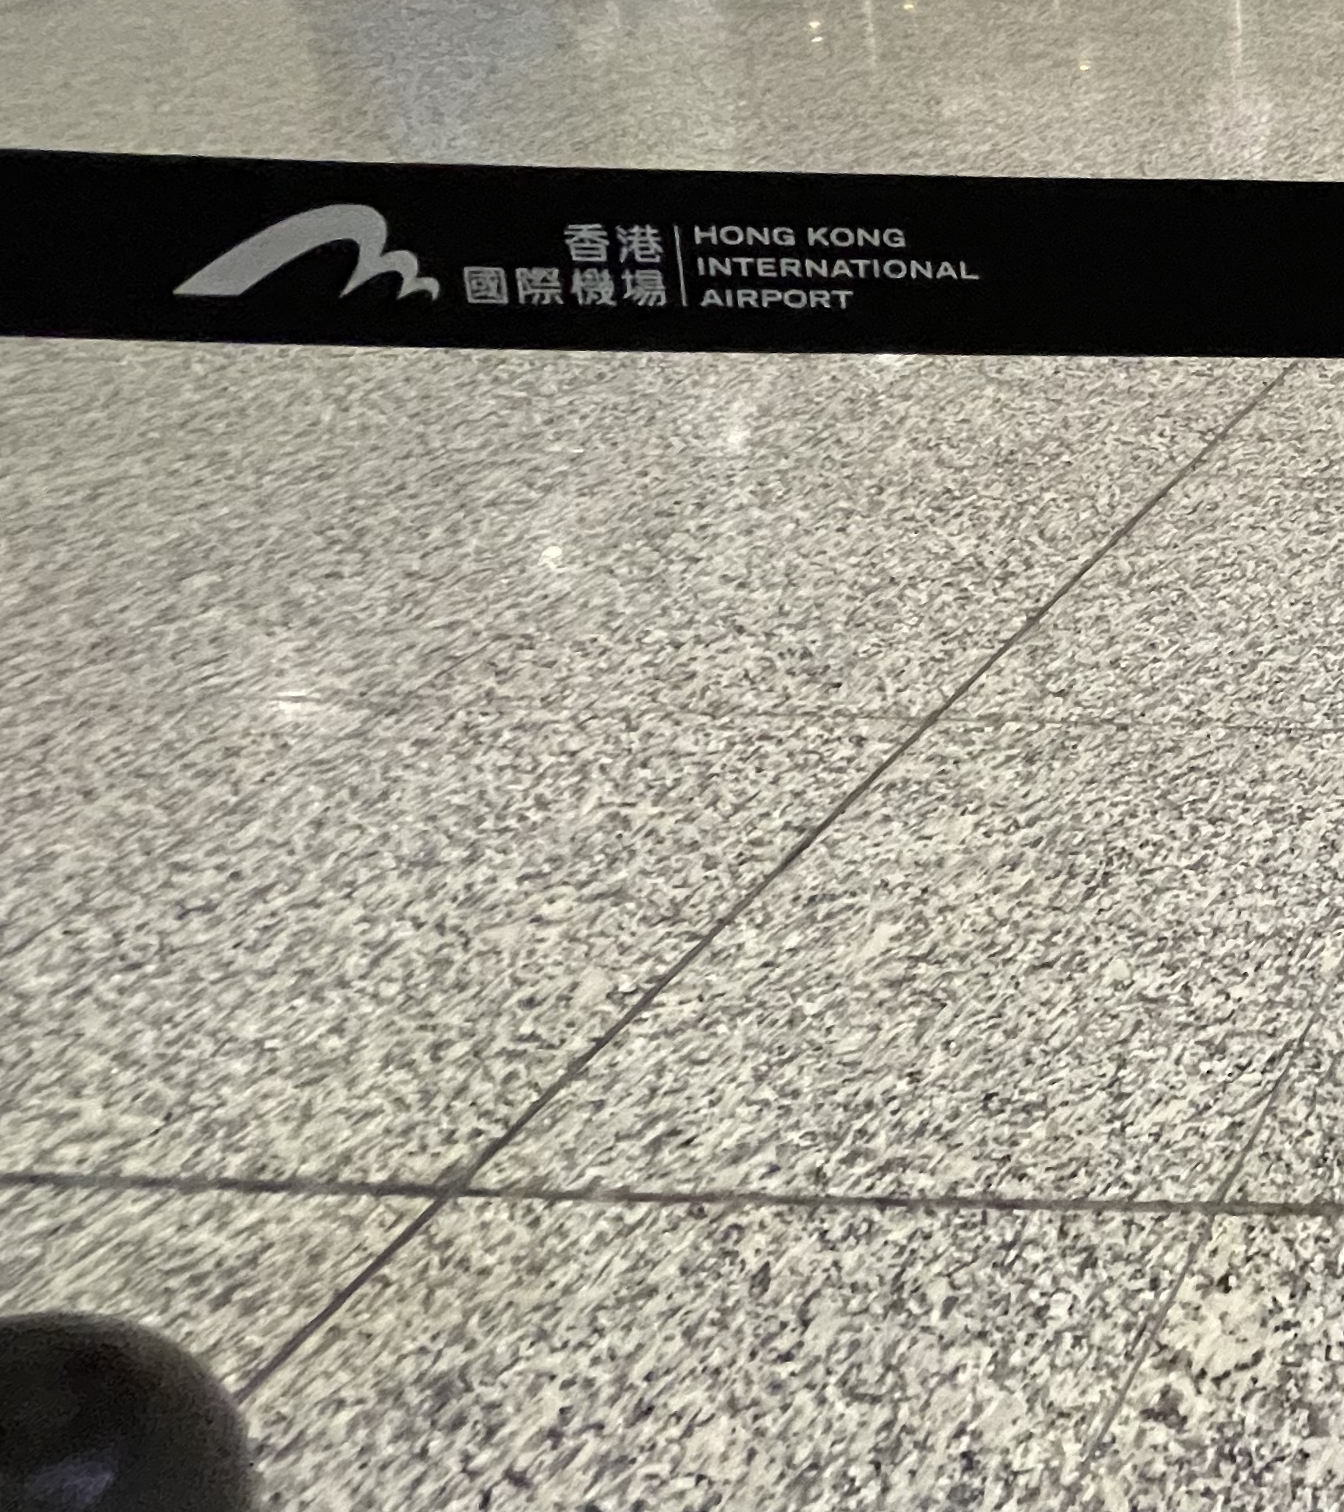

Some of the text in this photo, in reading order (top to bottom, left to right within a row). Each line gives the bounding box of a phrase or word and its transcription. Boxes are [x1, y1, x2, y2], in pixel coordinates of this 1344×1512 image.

[564, 223, 665, 264] 香港
[693, 225, 907, 248] HONG KONG
[697, 256, 981, 280] INTERNATIONAL
[463, 262, 667, 306] 國際機場
[699, 288, 855, 310] AIRPORT
